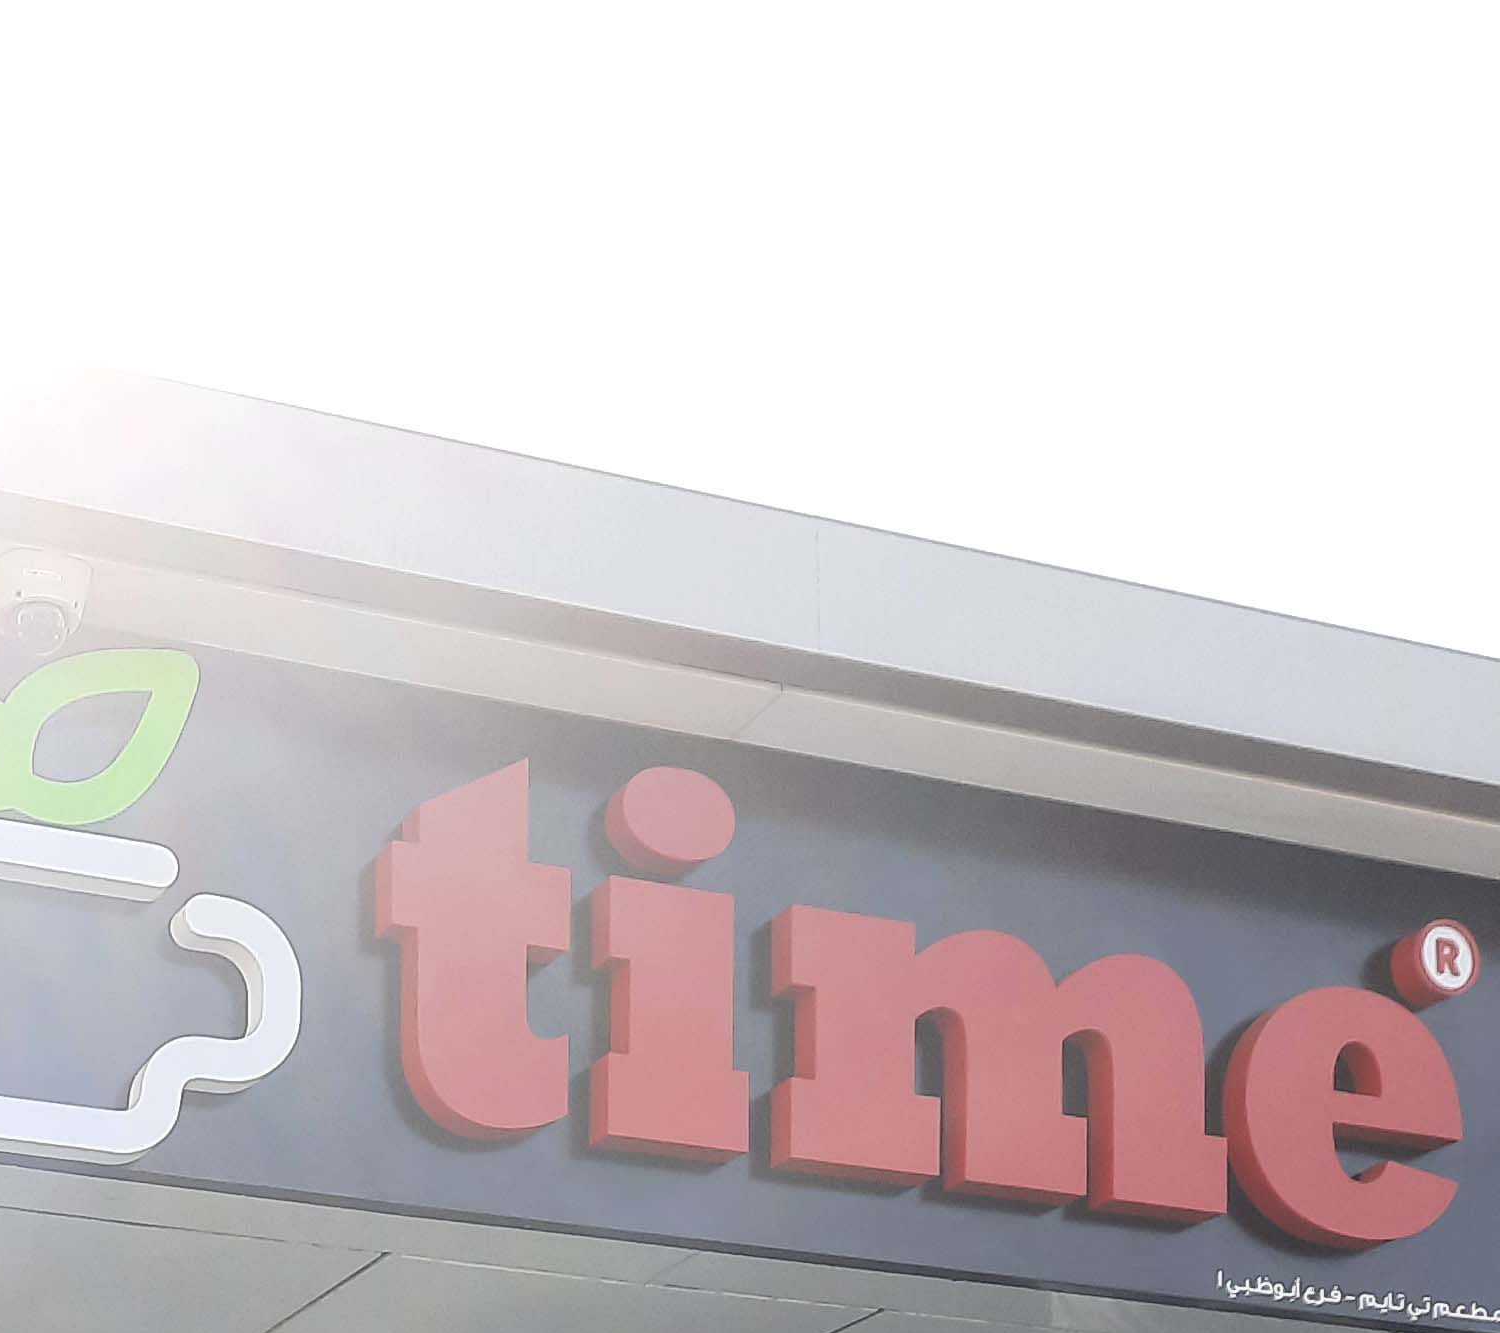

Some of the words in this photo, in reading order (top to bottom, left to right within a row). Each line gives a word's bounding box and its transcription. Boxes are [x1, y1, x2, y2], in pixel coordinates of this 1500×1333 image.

[374, 757, 1464, 1249] time
[1303, 1284, 1342, 1307] فرع
[1358, 1291, 1405, 1314] تايم
[1406, 1296, 1431, 1321] تي
